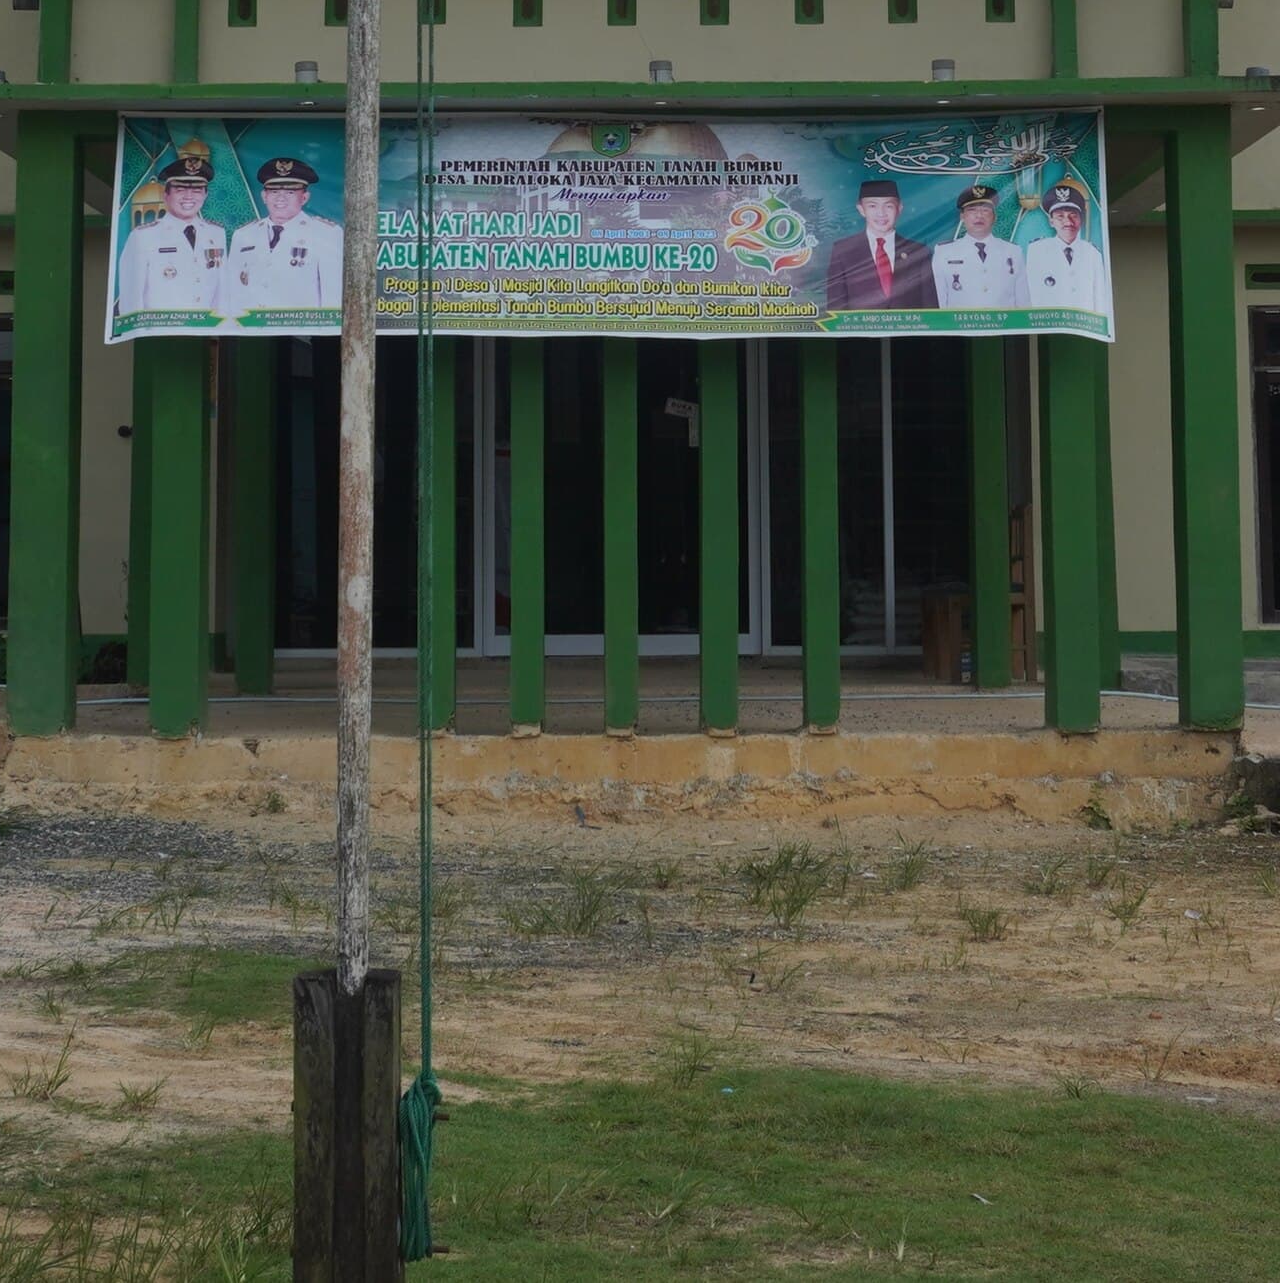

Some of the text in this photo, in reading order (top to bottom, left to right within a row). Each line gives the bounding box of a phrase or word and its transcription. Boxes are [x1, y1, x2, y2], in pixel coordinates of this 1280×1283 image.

[441, 160, 783, 172] PEMERINTAH KABUPATEN TANAH BUMBU
[424, 174, 800, 186] DESA INDRALOKA JAYA KECAMATAN KURANJI
[551, 187, 670, 207] Mengucapkan
[377, 212, 580, 237] ELAMAT HARI JADI
[605, 229, 626, 240] April
[671, 229, 693, 240] April
[377, 244, 717, 269] ABUPATEN TANAH BUMBU KE-20
[444, 277, 452, 291] 1
[455, 278, 489, 292] Desa
[492, 278, 499, 291] 1
[503, 279, 543, 295] Masjid
[548, 279, 572, 293] Kita
[577, 280, 637, 296] Langitkan
[641, 280, 671, 294] Do'a
[676, 280, 699, 294] dan
[703, 281, 756, 295] Bumikan
[759, 281, 791, 296] Iktiar
[506, 300, 543, 313] Tanah
[548, 300, 593, 314] Bumbu
[596, 300, 652, 317] Bersujud
[656, 301, 702, 317] Menuju
[705, 301, 759, 316] Serambi
[763, 301, 817, 316] Madinah
